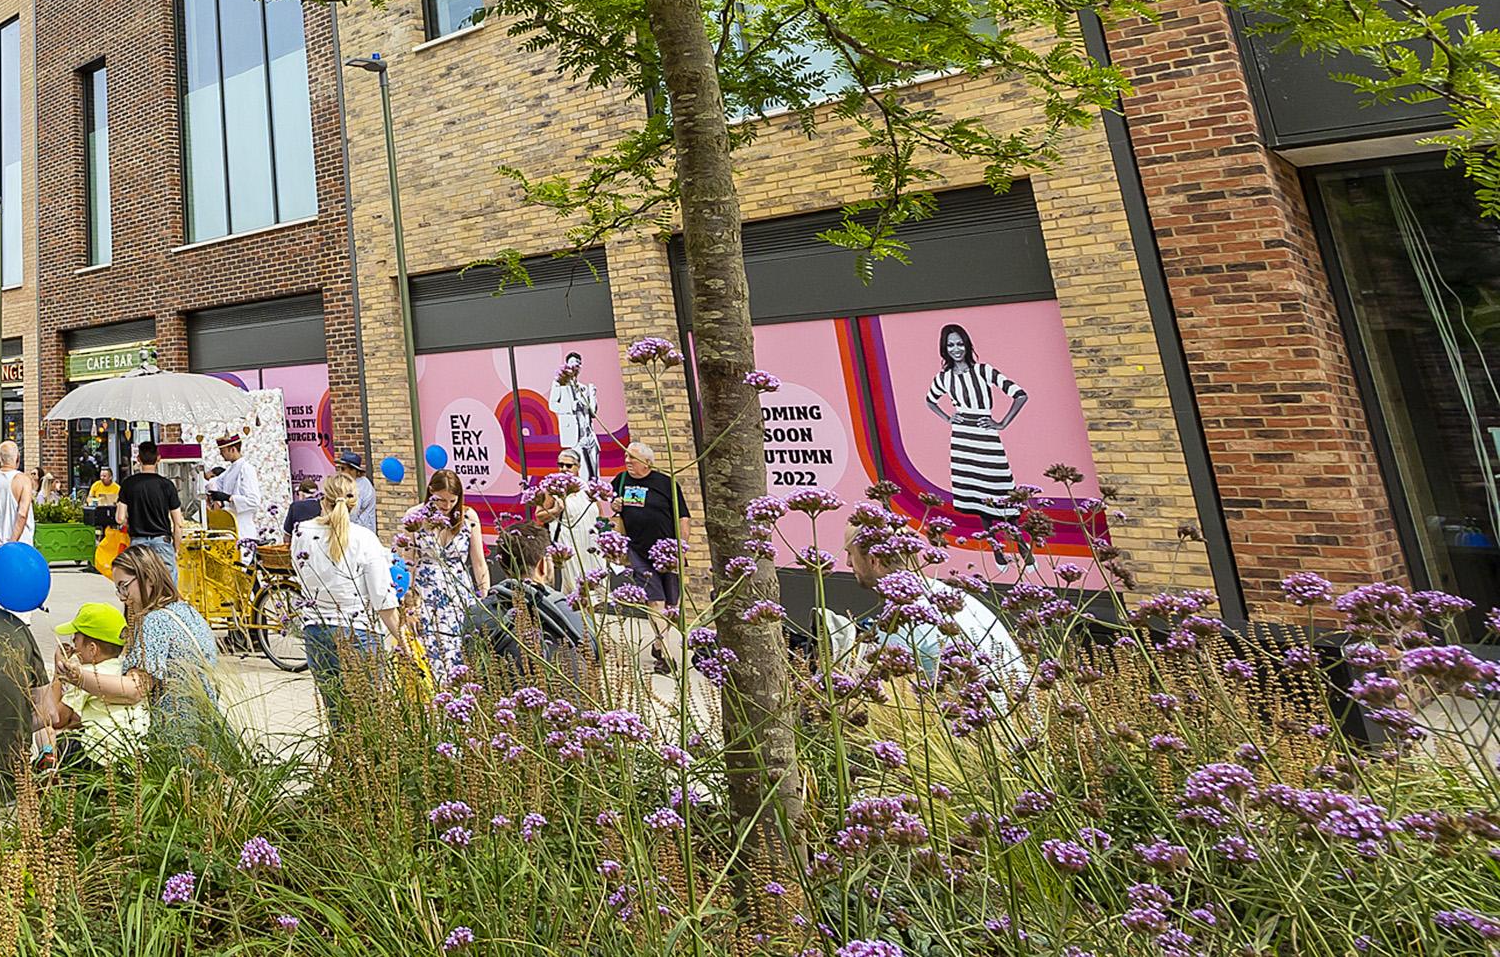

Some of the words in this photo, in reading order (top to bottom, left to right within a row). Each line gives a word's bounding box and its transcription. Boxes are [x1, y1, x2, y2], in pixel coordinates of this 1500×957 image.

[86, 355, 110, 370] CAFE
[113, 353, 133, 368] BAR
[286, 406, 305, 416] THIS
[305, 405, 313, 415] IS
[761, 405, 822, 421] OMING
[291, 418, 316, 429] TASTY
[450, 414, 471, 429] EV
[452, 430, 483, 445] ERY
[764, 427, 813, 442] SOON
[453, 446, 489, 461] MAN
[764, 449, 833, 464] UTUMN
[455, 464, 490, 475] EGHAM
[772, 471, 818, 486] 2022
